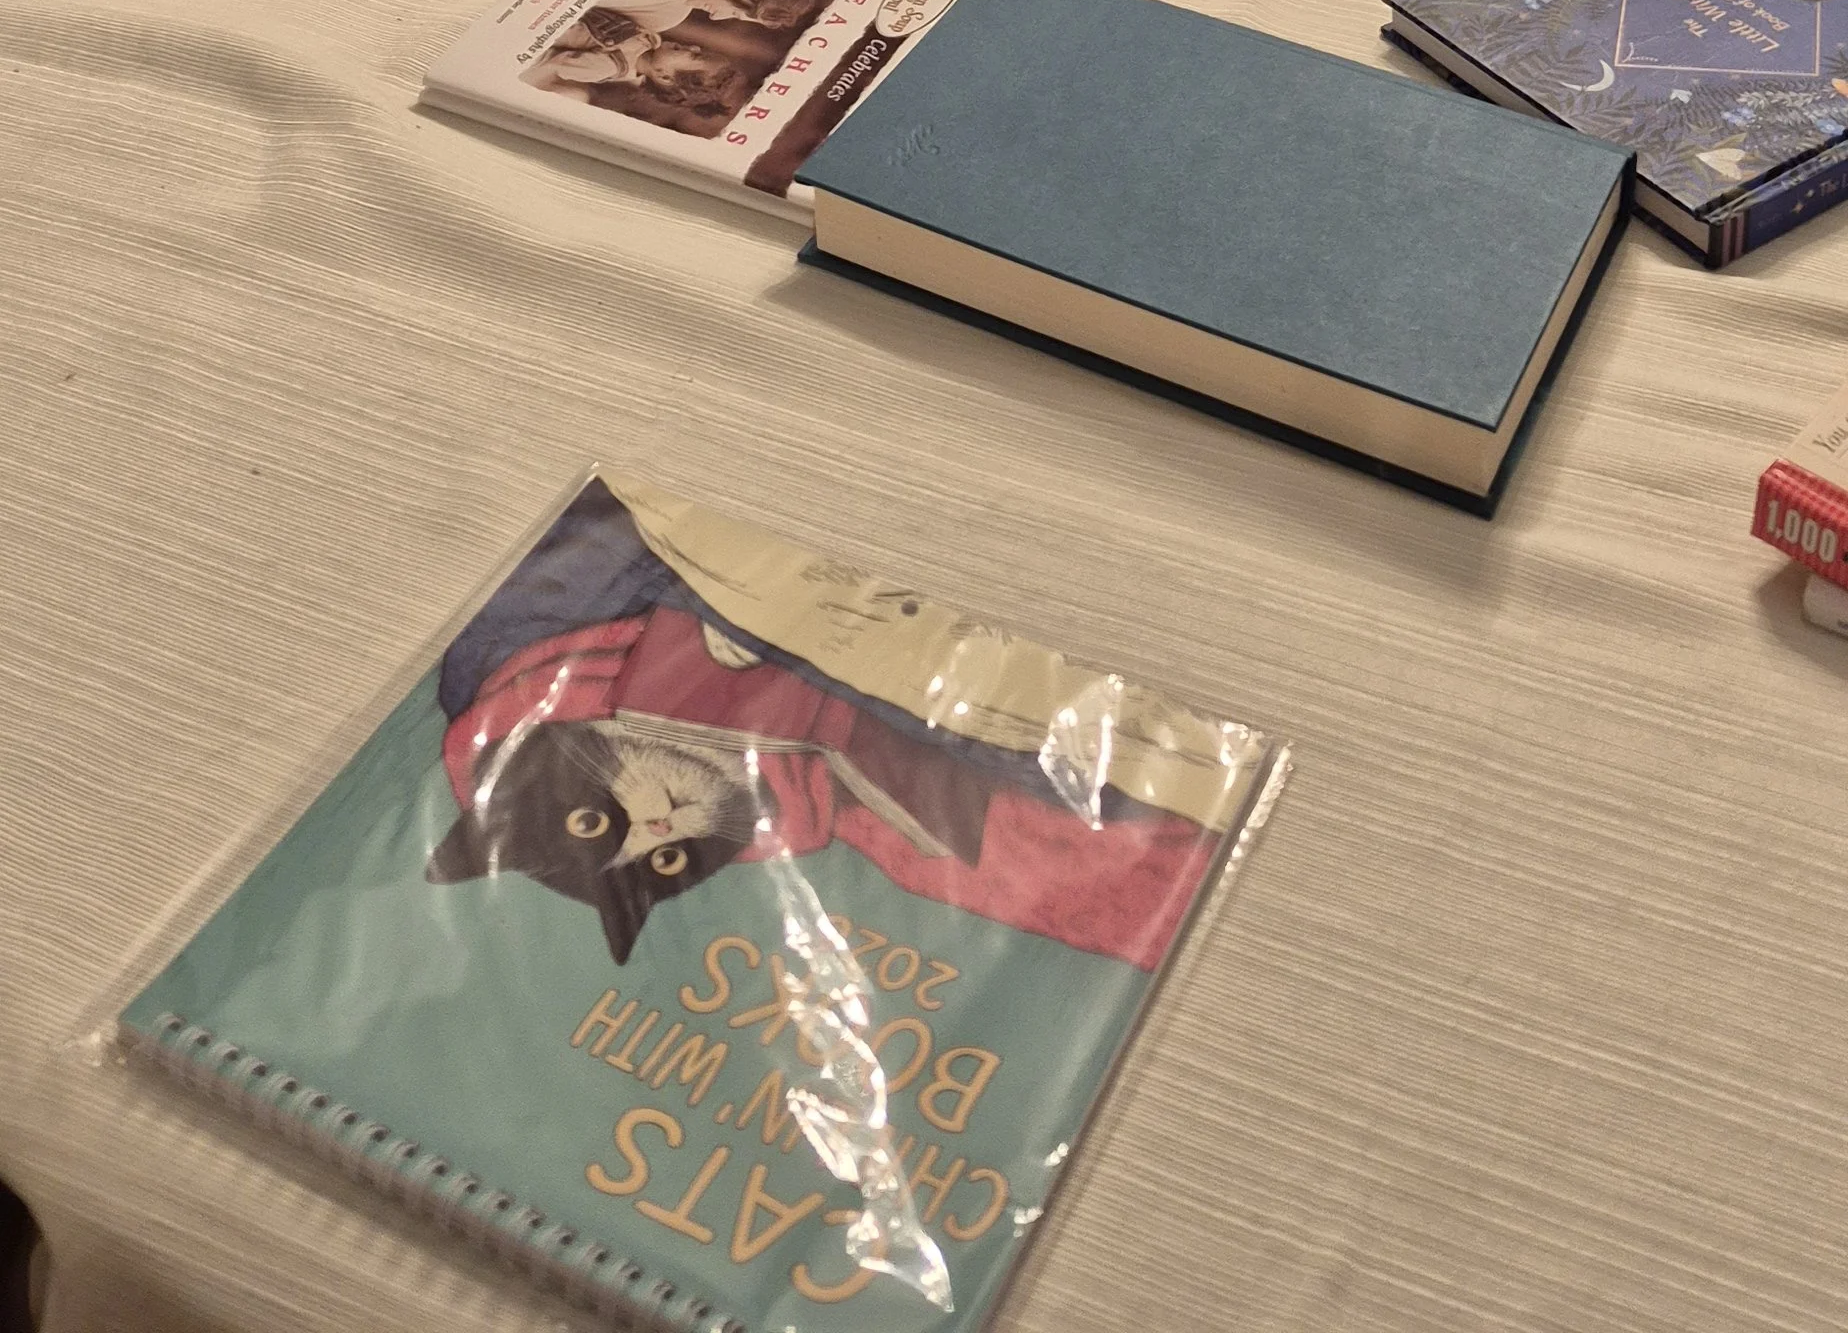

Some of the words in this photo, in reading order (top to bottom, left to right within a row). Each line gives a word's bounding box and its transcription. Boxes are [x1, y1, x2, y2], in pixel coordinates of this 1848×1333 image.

[531, 7, 577, 53] Photographs
[888, 7, 924, 33] Soup
[1683, 18, 1709, 38] The
[1728, 19, 1780, 53] Little
[1752, 6, 1792, 32] Book
[516, 51, 533, 64] by
[827, 39, 887, 102] Celebrates
[1766, 499, 1838, 564] 1,000
[570, 988, 730, 1106] WITH
[679, 936, 1002, 1133] BOOKS
[584, 1106, 893, 1305] CATS
